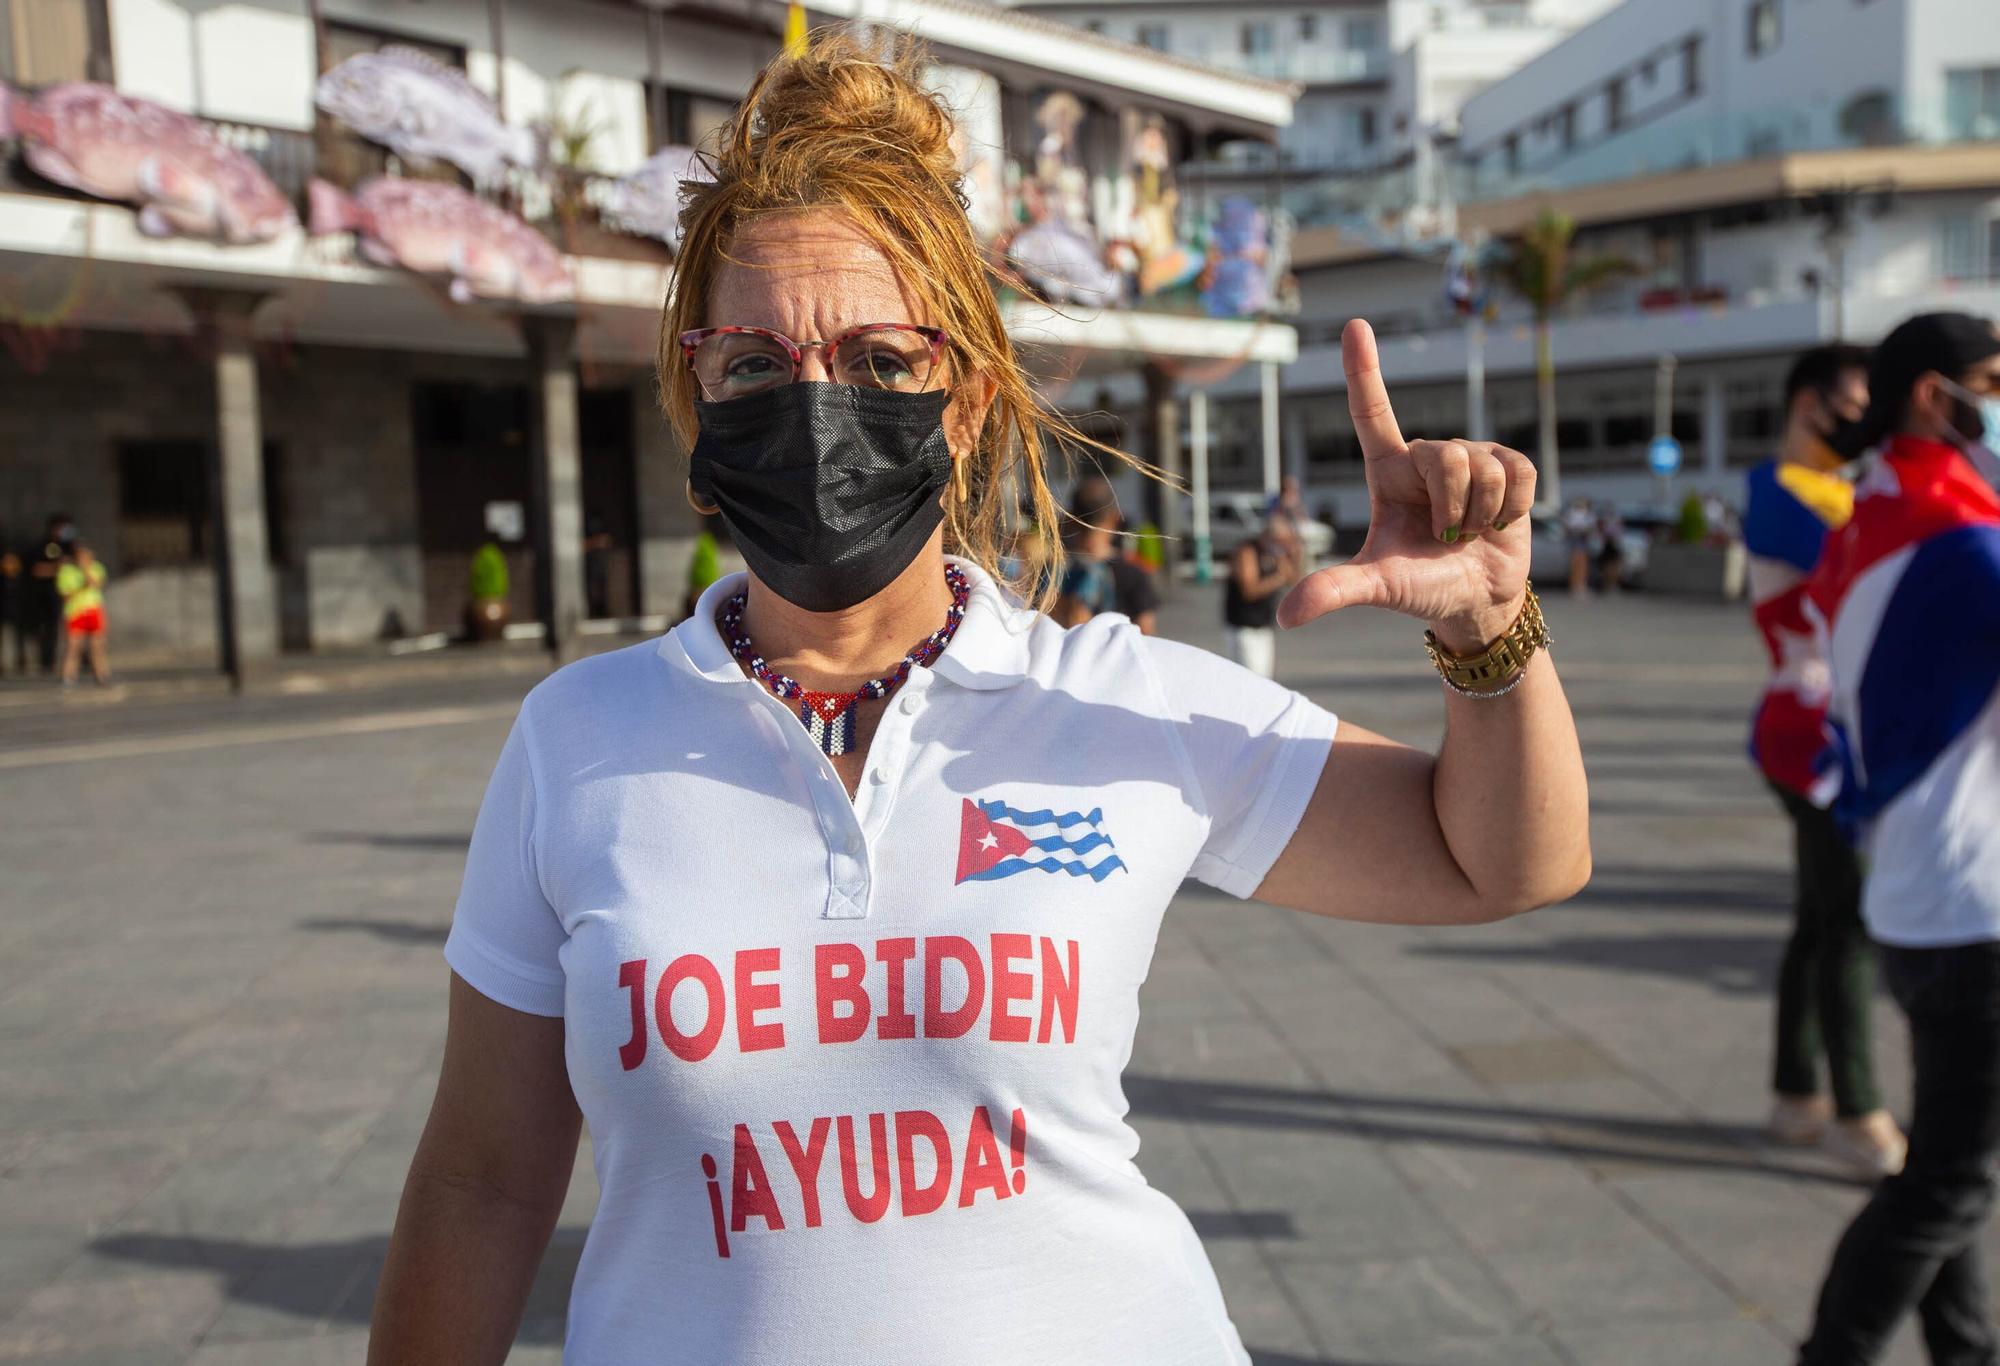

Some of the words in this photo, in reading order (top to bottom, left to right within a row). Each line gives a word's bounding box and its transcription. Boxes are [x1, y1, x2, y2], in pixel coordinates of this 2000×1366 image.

[619, 947, 786, 1071] JOE
[814, 933, 1080, 1045] BIDEN
[701, 1106, 1027, 1258] ¡AYUDA!
